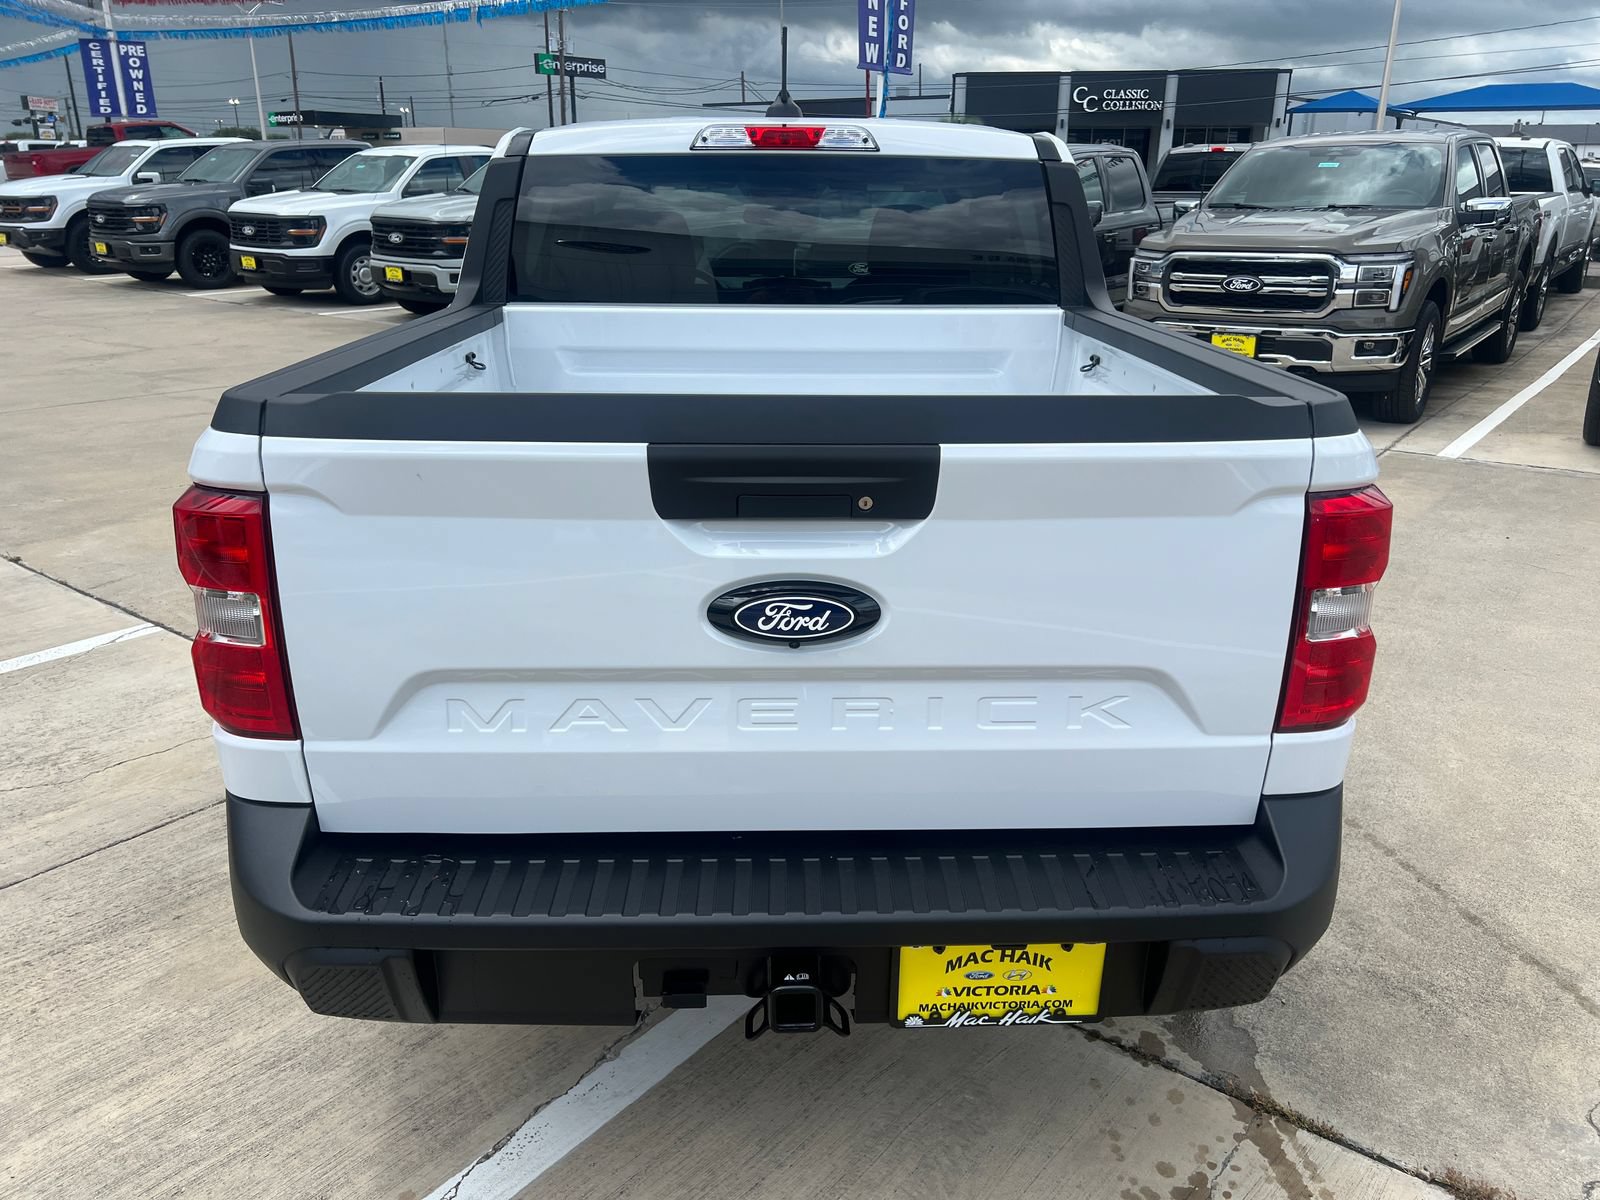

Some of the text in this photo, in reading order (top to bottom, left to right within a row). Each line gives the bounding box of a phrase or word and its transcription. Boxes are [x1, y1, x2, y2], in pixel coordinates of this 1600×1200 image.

[896, 0, 909, 68] FORD
[119, 44, 145, 57] PRE
[539, 58, 605, 74] enerprise
[88, 42, 112, 114] CERTIFIED
[128, 57, 147, 114] OWNED
[1103, 89, 1149, 99] CLASSIC
[1102, 100, 1163, 111] COLLISION
[268, 112, 303, 124] enterprie
[1229, 279, 1254, 290] Ford
[757, 602, 832, 632] Ford
[446, 696, 1132, 733] MAVERICK
[945, 949, 1053, 974] MAC HAIK
[968, 972, 989, 980] Ford
[952, 984, 1041, 997] VICTORIA
[918, 999, 1073, 1013] MACHAIKVICTORIA.COM
[945, 1008, 1052, 1028] Mac Haik
